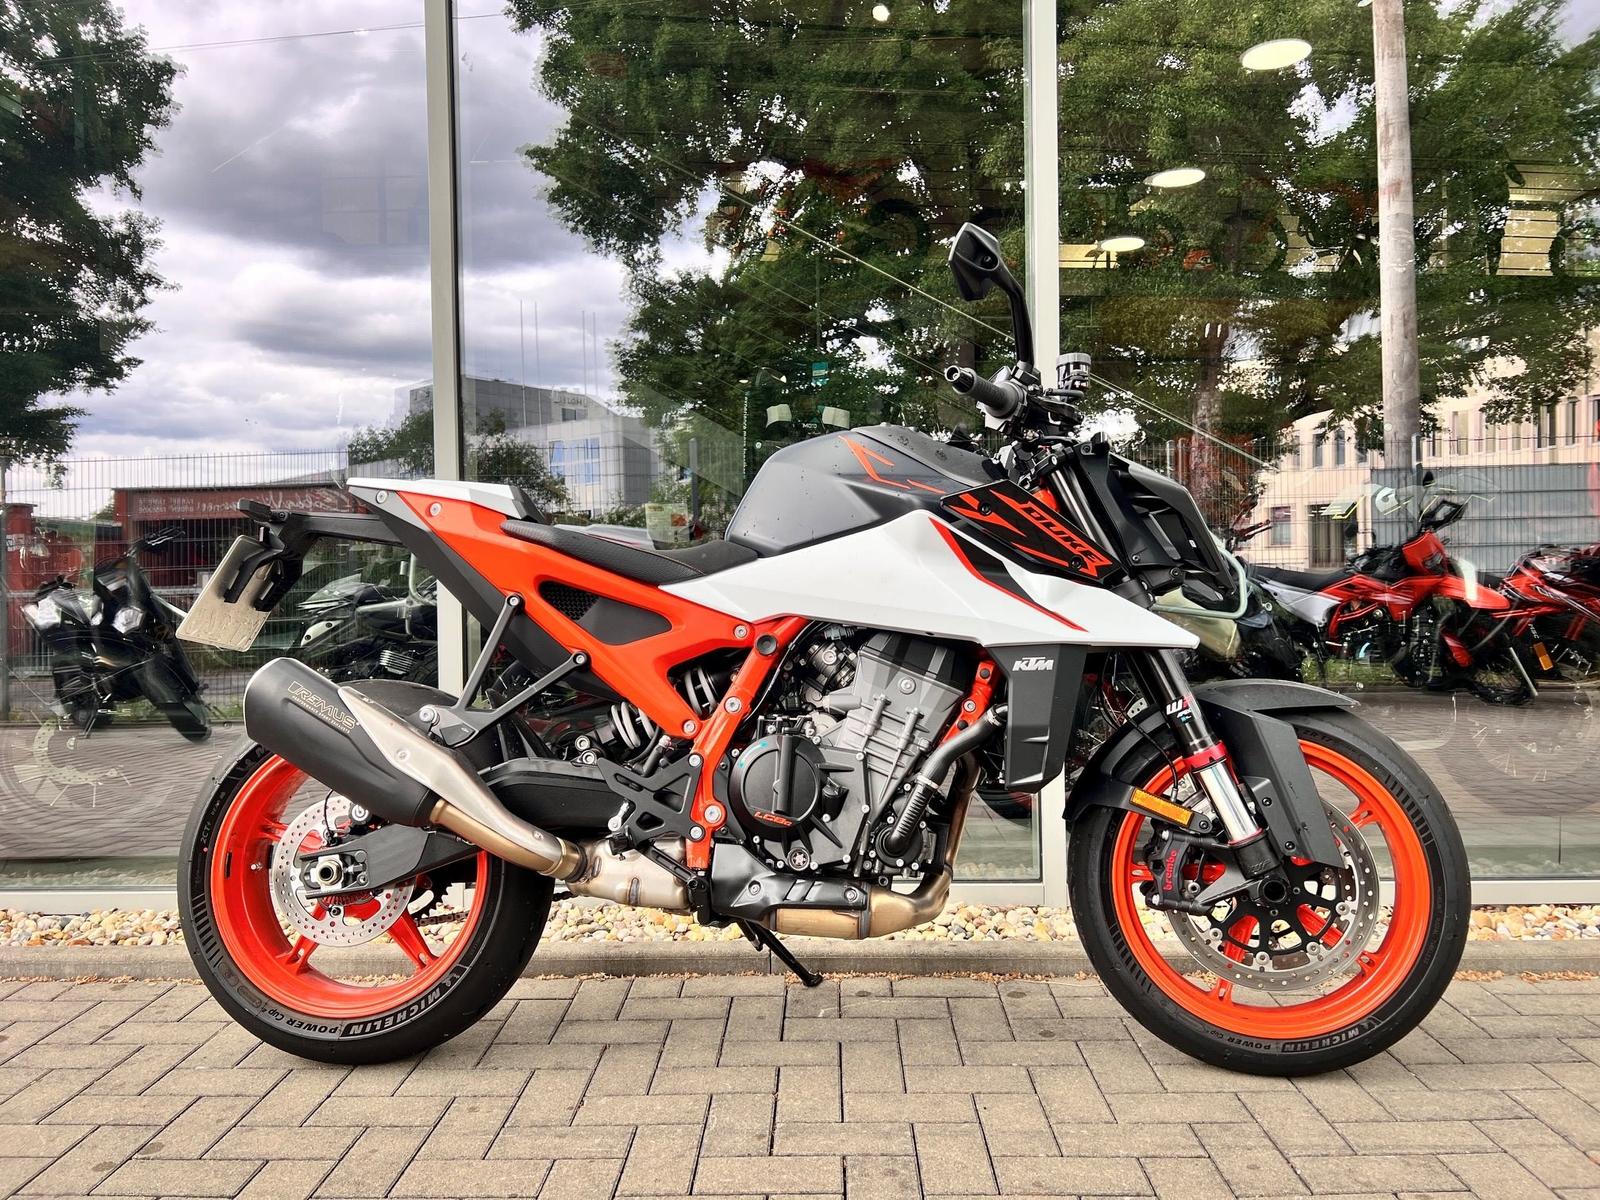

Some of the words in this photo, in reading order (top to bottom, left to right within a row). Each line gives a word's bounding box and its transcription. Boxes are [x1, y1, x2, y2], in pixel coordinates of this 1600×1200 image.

[1020, 502, 1106, 565] DUKE
[1012, 656, 1054, 671] KTM
[288, 681, 356, 729] REMUS
[1163, 849, 1178, 892] brembo
[286, 1018, 339, 1035] POWER
[349, 986, 441, 1035] MICHELIN
[1227, 1036, 1272, 1051] POWER
[1283, 1027, 1360, 1053] MICHELIN
